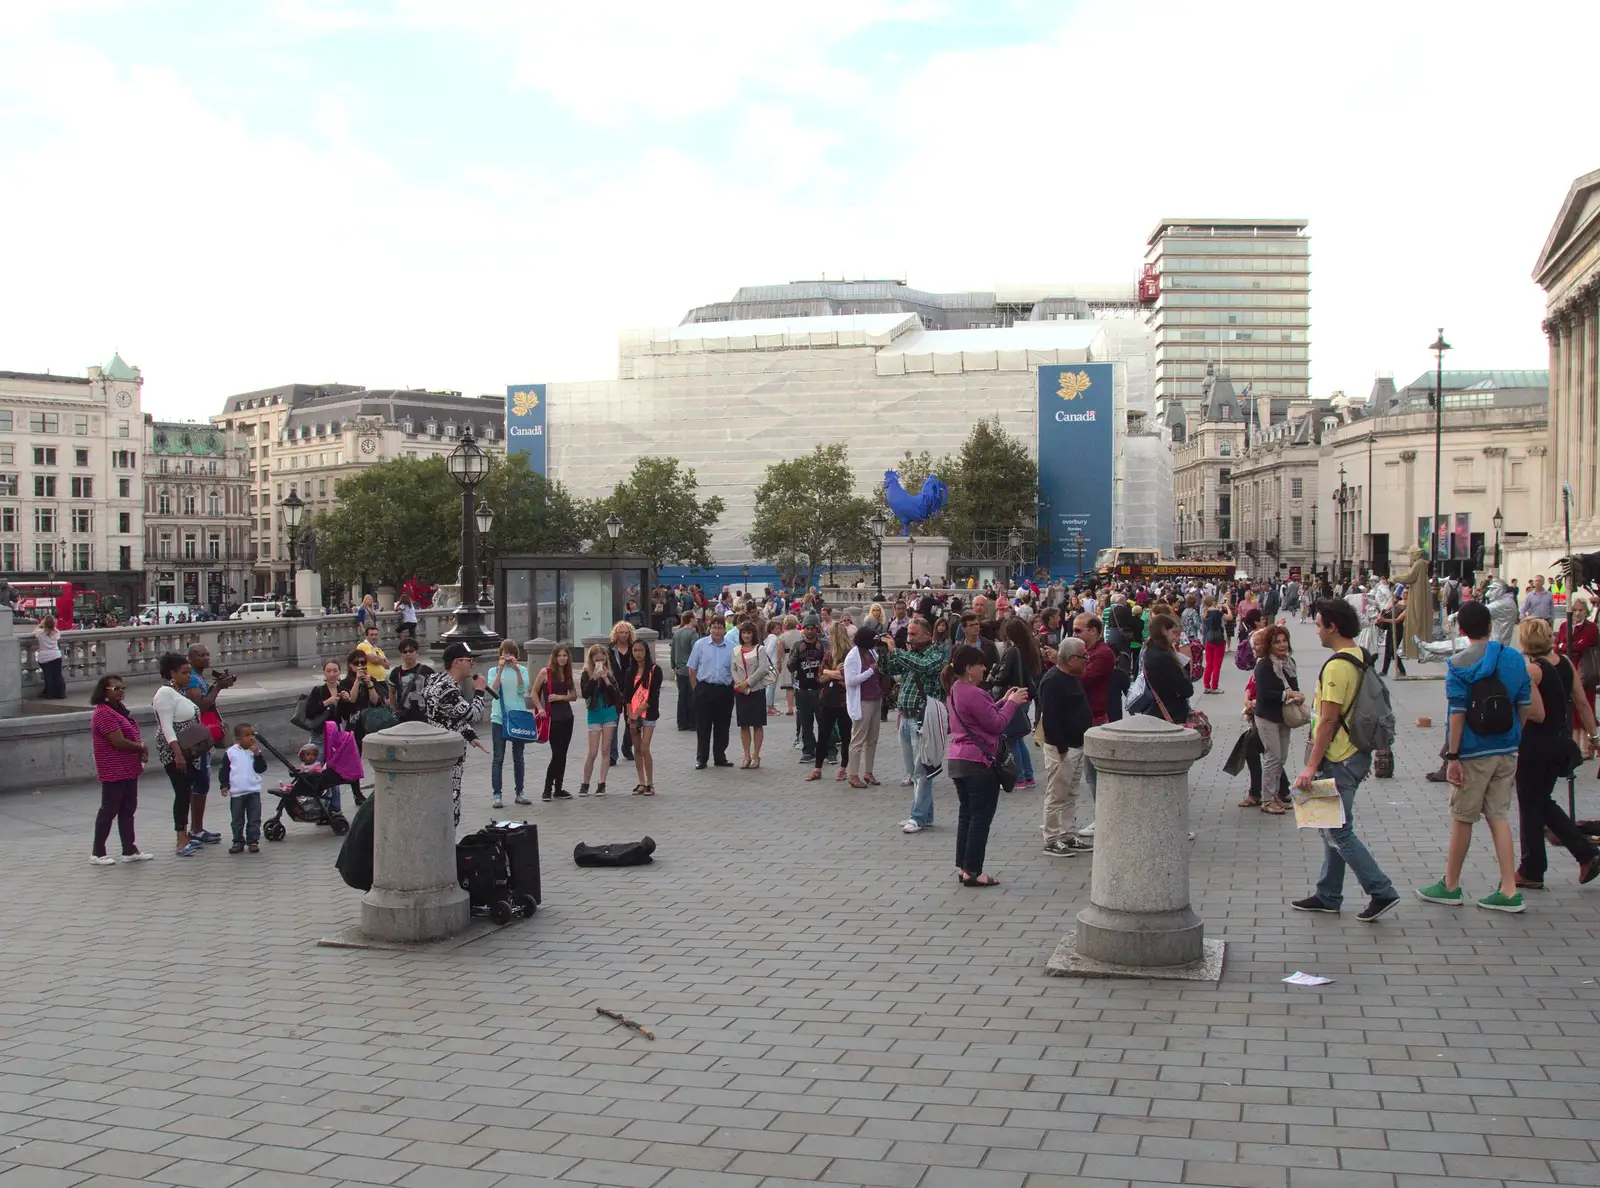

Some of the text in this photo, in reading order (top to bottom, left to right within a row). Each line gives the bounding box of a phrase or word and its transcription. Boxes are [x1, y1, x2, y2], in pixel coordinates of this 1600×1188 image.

[1055, 410, 1096, 422] Canada
[510, 425, 542, 436] Canada
[1180, 566, 1195, 574] TOUR
[1204, 566, 1227, 574] LONDON
